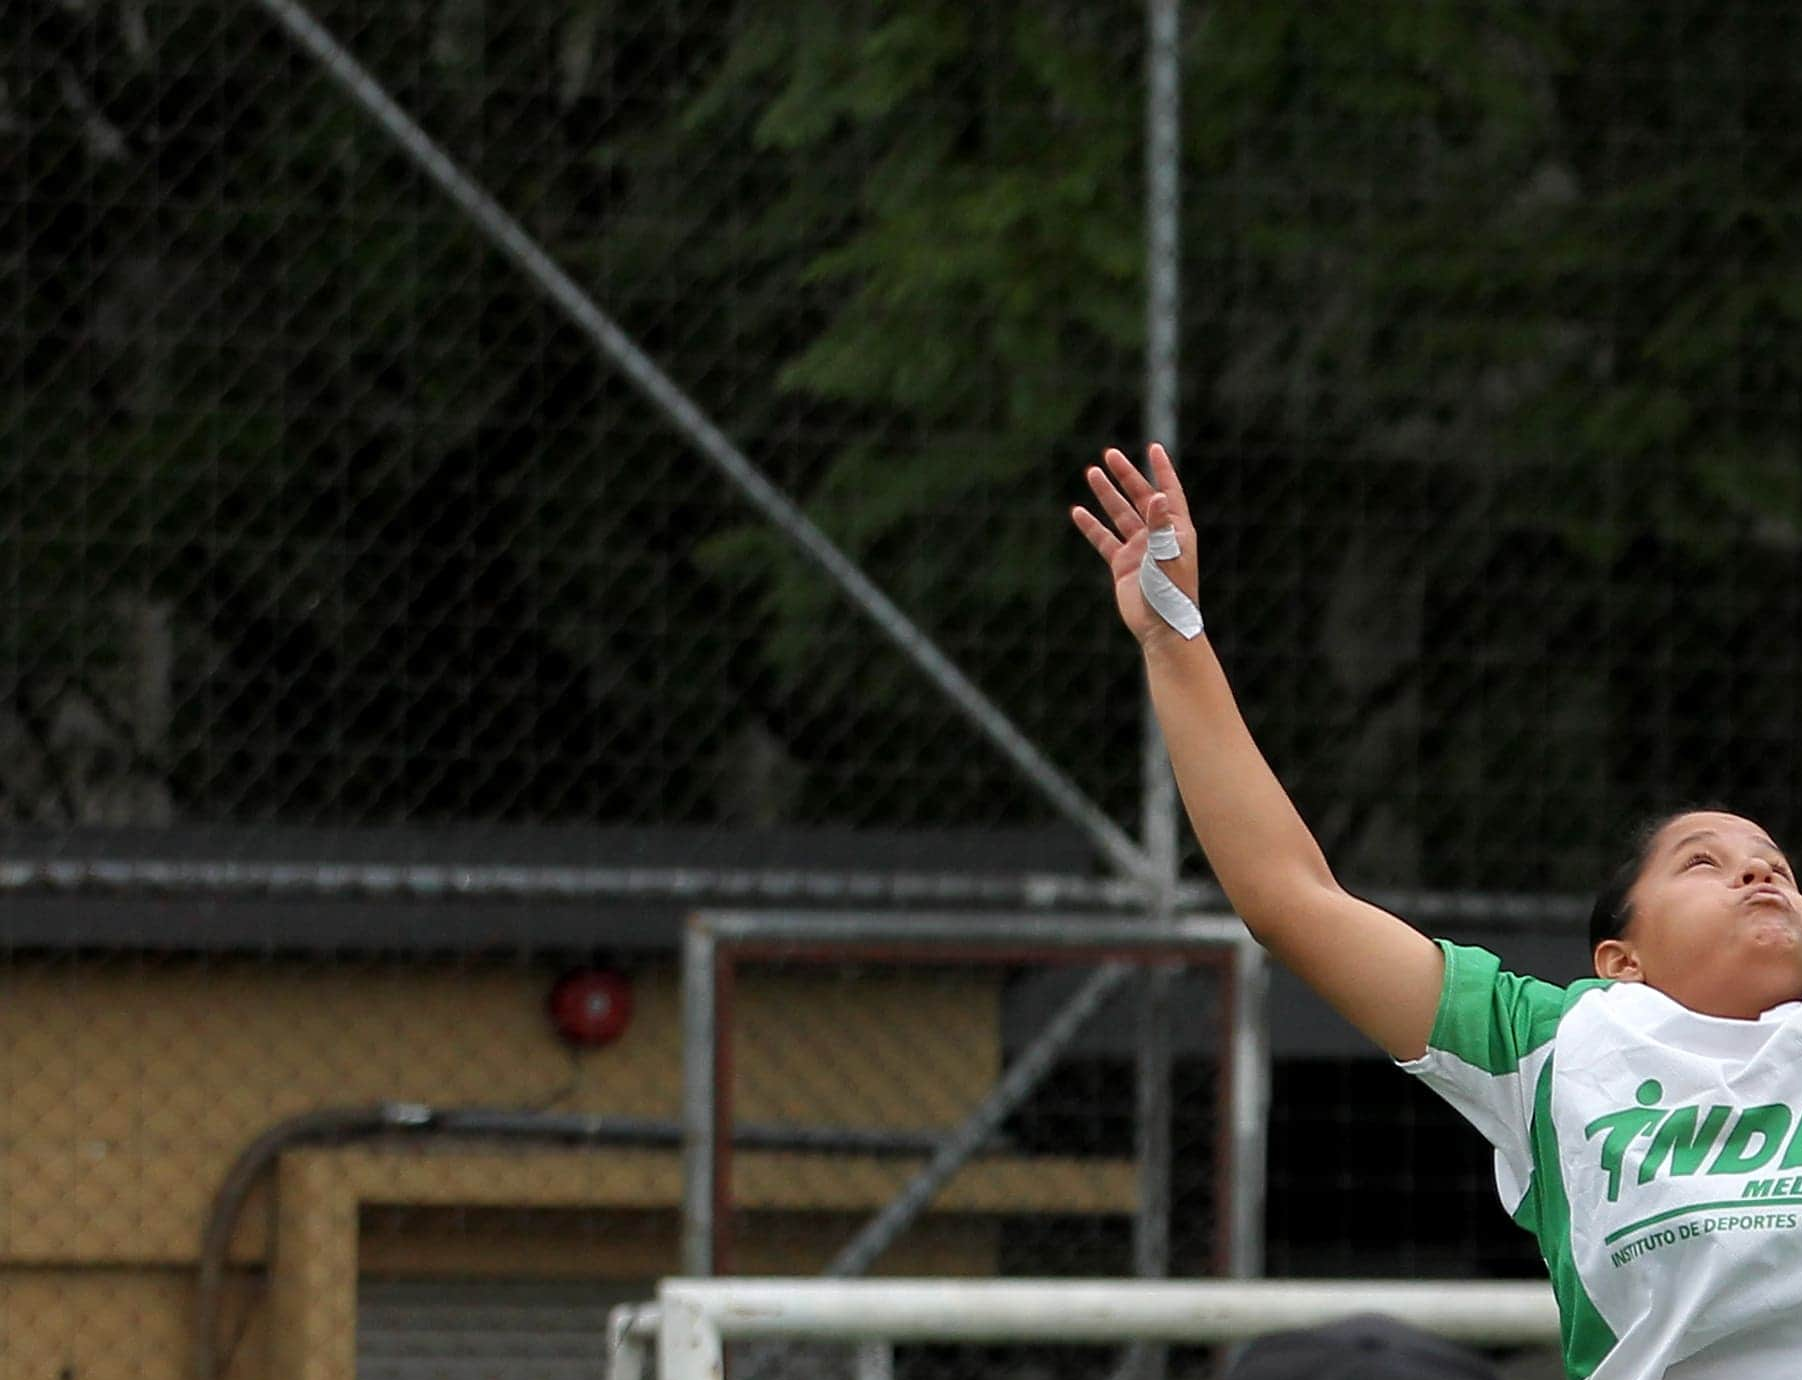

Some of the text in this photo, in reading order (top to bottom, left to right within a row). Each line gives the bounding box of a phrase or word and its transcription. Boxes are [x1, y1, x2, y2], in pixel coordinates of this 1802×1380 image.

[1611, 1229, 1676, 1268] INSTITUTO
[1678, 1221, 1700, 1240] DE
[1703, 1213, 1796, 1233] DEPORTES
